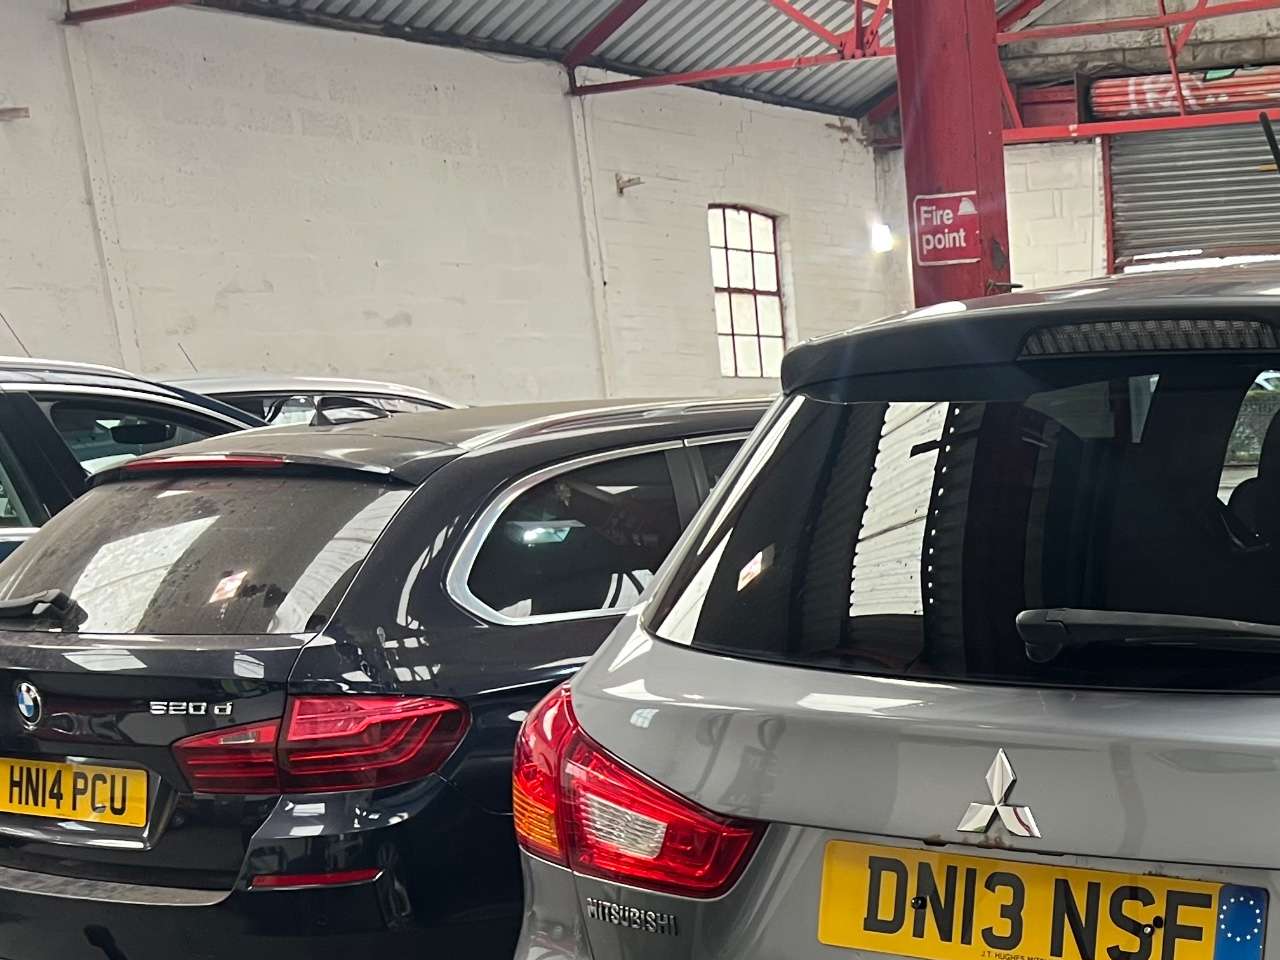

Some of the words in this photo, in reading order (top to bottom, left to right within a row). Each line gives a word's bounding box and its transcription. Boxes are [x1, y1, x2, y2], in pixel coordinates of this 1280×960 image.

[920, 205, 953, 225] Fire
[921, 228, 966, 255] point
[150, 701, 207, 715] 520
[9, 764, 64, 809] HN14
[71, 771, 128, 816] PCU
[586, 897, 679, 936] MITSUBISHI
[862, 855, 1026, 951] DN13
